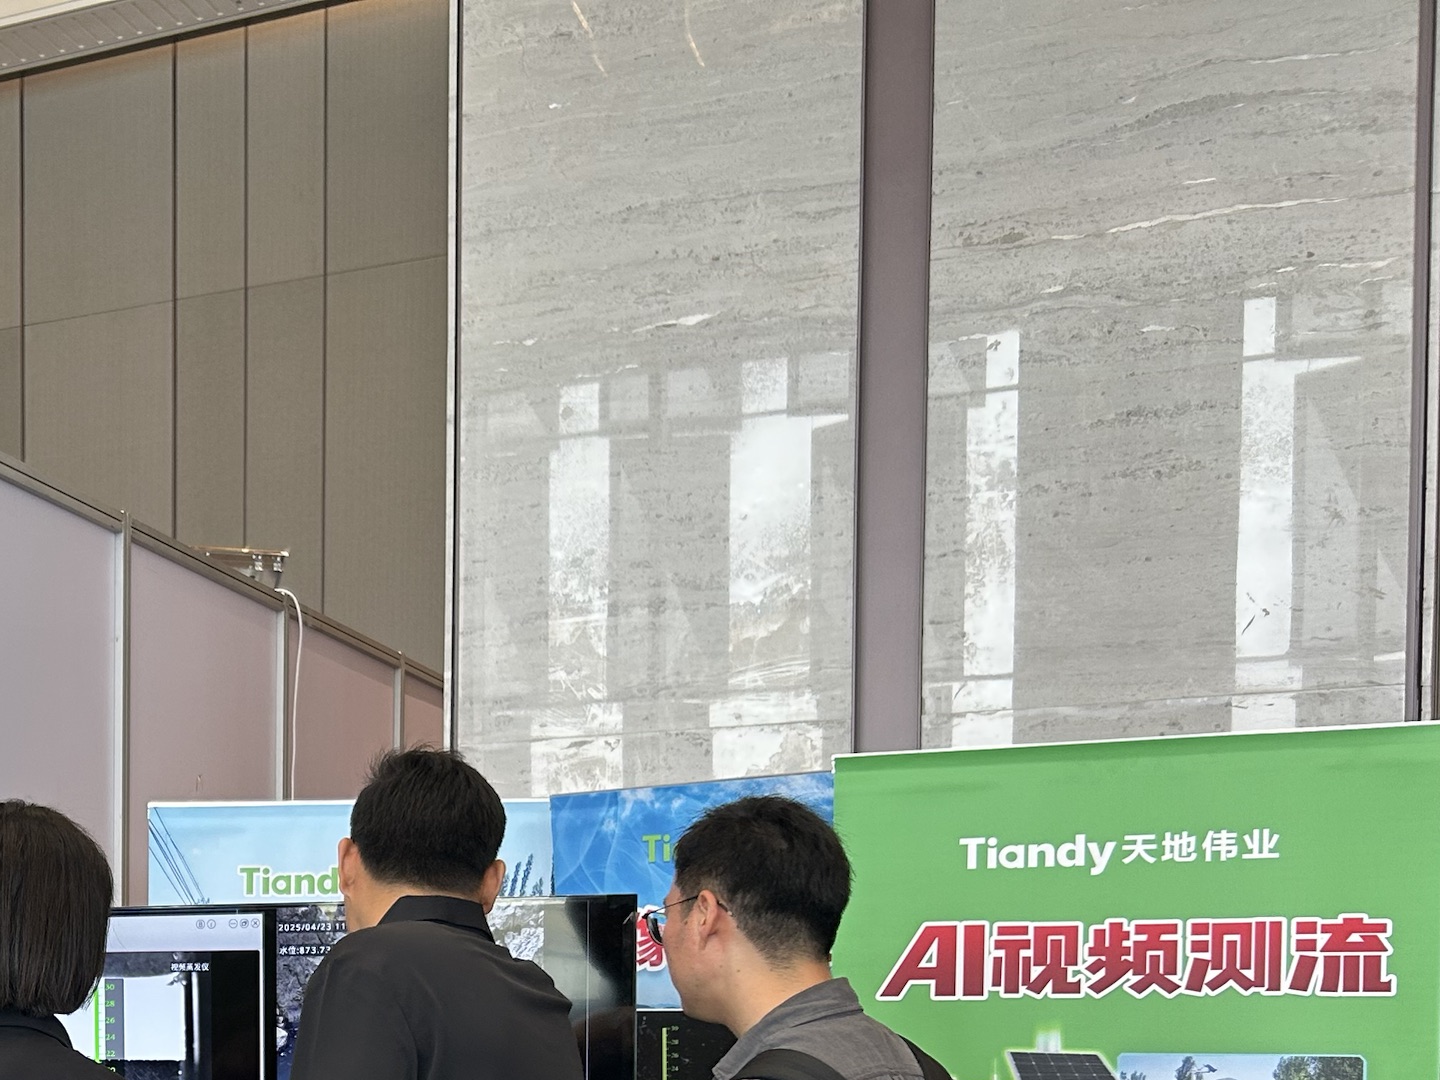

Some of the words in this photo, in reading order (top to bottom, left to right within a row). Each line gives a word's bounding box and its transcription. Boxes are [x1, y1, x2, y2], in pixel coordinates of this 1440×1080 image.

[959, 833, 1117, 875] Tiandy
[1121, 828, 1281, 865] 天地伟业
[239, 867, 339, 896] Tiand
[278, 923, 332, 932] 2025/04/23
[876, 912, 1398, 1001] AI视频测流
